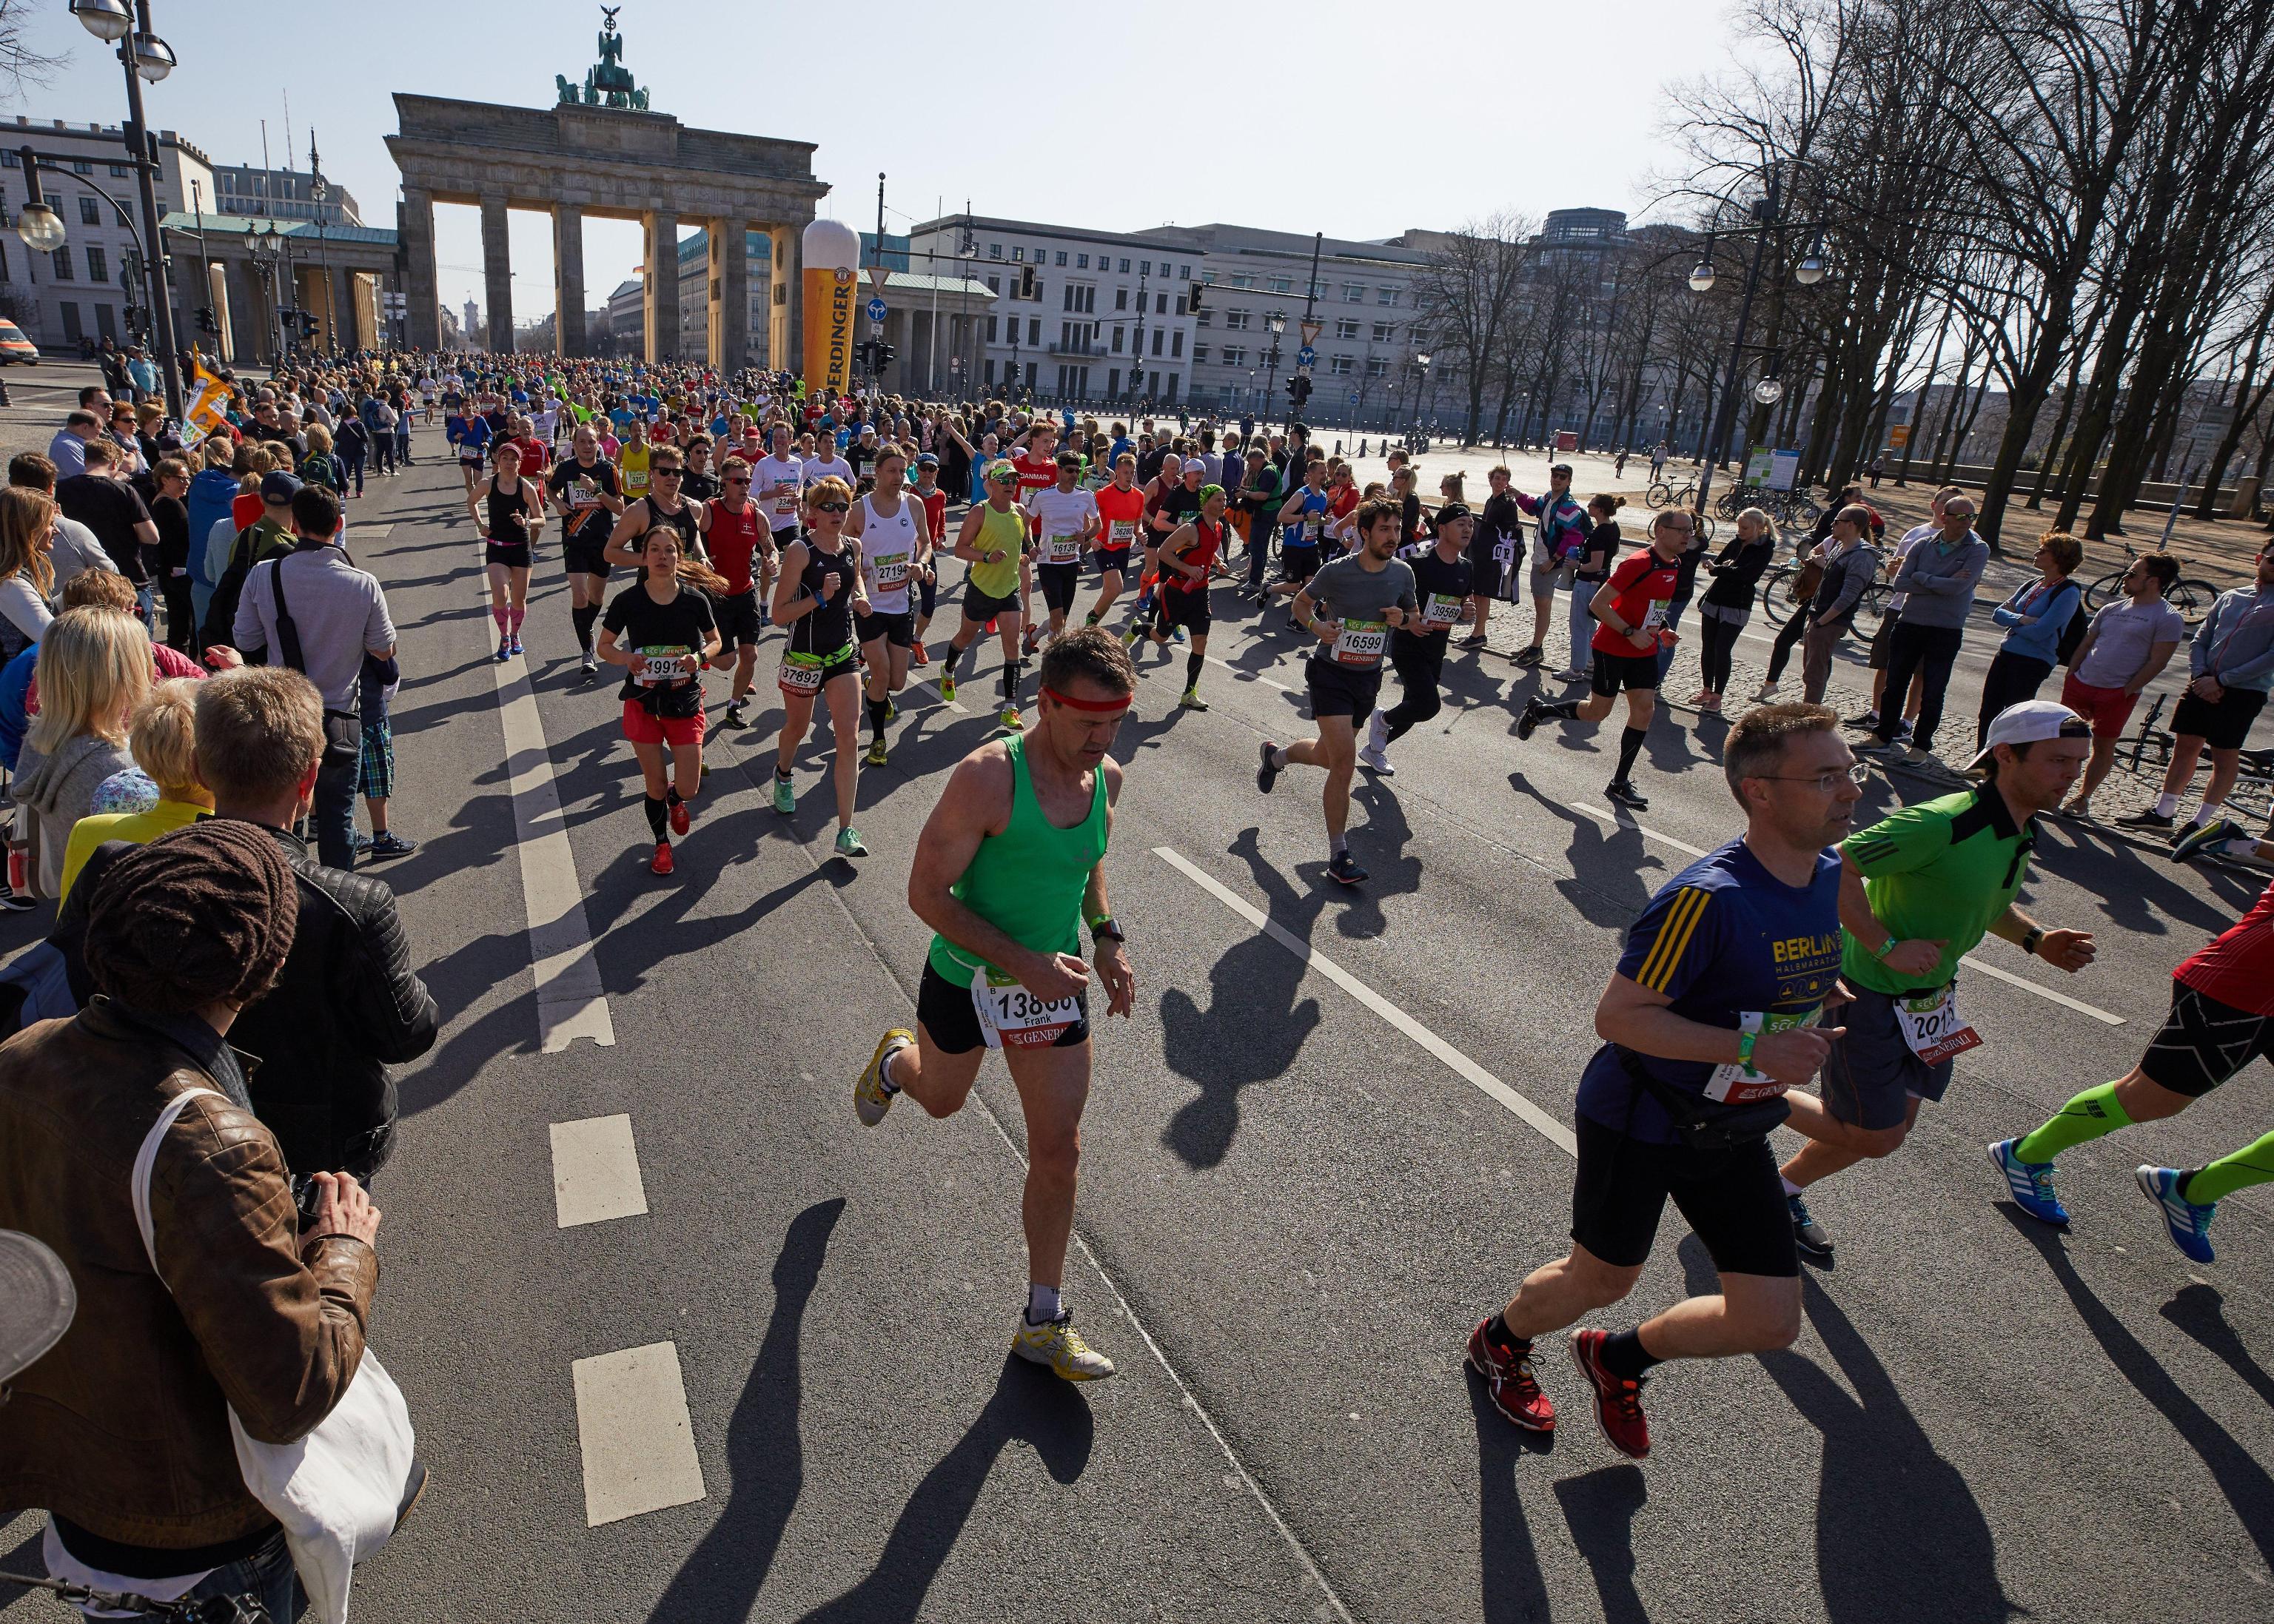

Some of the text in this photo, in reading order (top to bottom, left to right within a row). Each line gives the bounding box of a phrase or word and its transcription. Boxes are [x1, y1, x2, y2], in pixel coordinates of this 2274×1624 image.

[827, 284, 851, 386] ERDINGER
[1053, 543, 1076, 552] 16139
[879, 564, 908, 579] 27194
[1432, 605, 1460, 618] 39569
[1345, 634, 1381, 649] 16599
[782, 667, 819, 684] 37892
[1772, 935, 1837, 963] BERLIN
[1024, 1013, 1052, 1027] Frank
